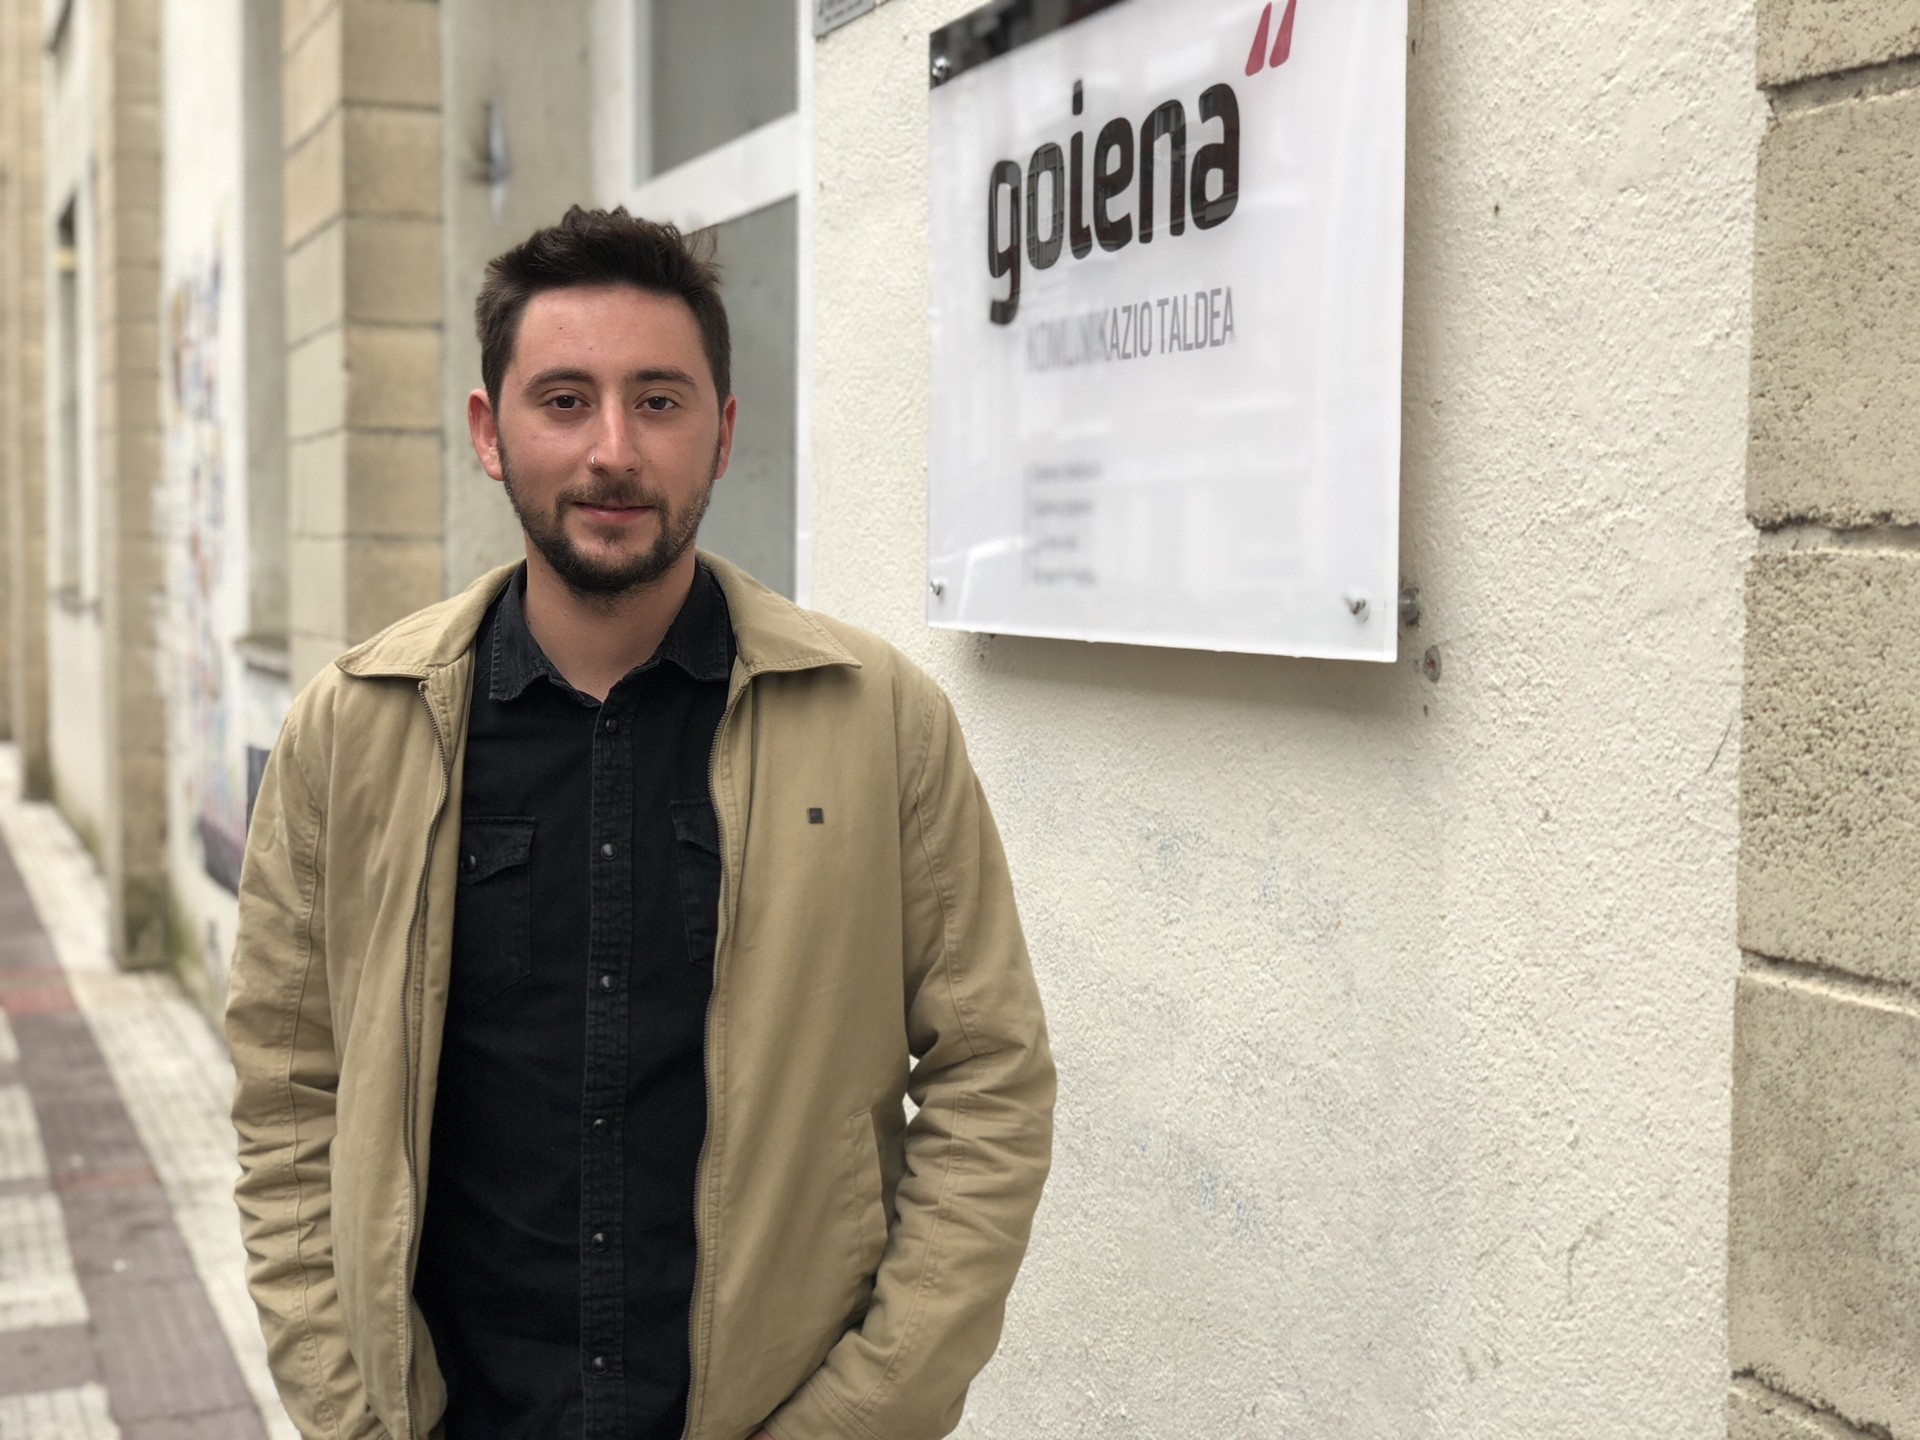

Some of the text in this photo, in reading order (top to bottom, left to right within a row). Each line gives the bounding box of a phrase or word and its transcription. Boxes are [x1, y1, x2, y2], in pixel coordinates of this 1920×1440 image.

[988, 79, 1240, 325] goiena
[1027, 286, 1234, 374] OKAZIO TALDEA
